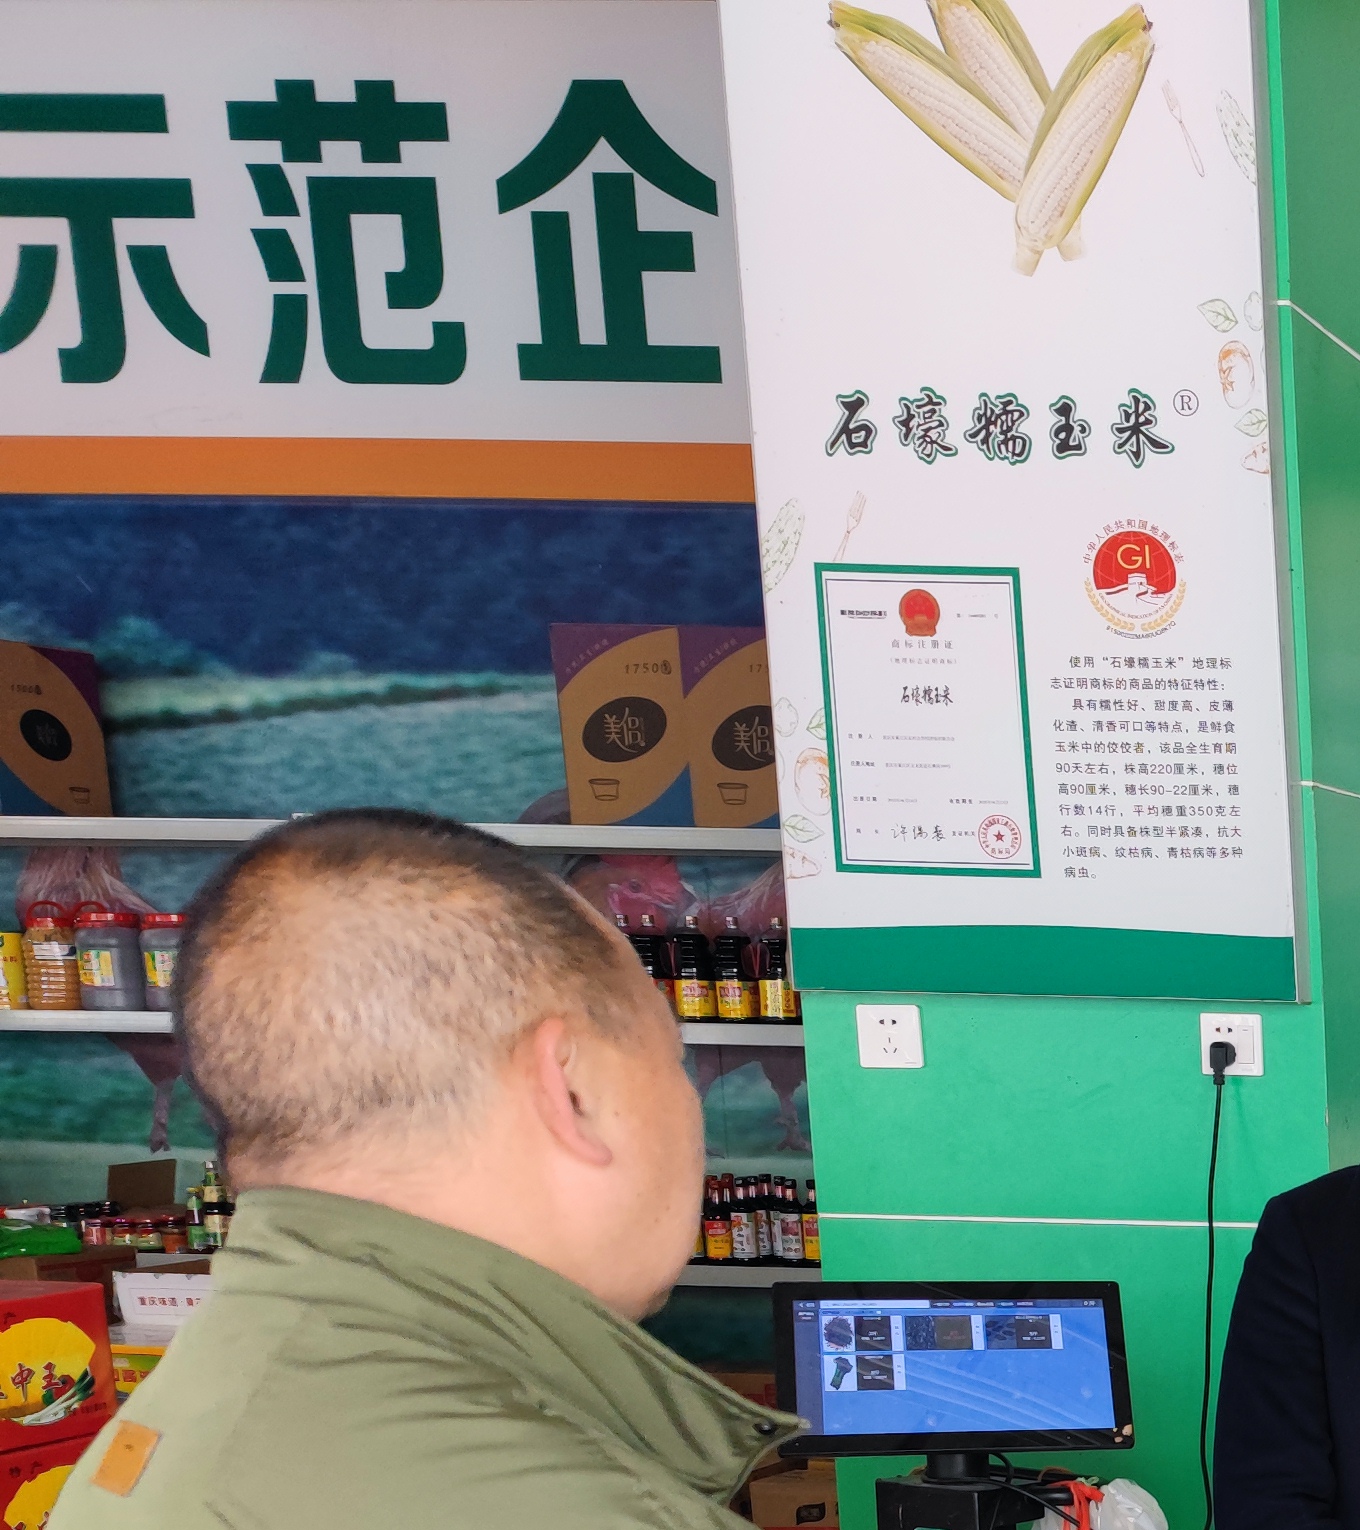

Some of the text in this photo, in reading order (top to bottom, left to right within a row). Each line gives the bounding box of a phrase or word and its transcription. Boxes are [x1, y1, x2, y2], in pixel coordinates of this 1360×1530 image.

[0, 78, 723, 385] 示范企
[825, 386, 1176, 468] 石壕糯玉米
[1116, 543, 1151, 570] GI
[1064, 867, 1097, 880] 病虫。
